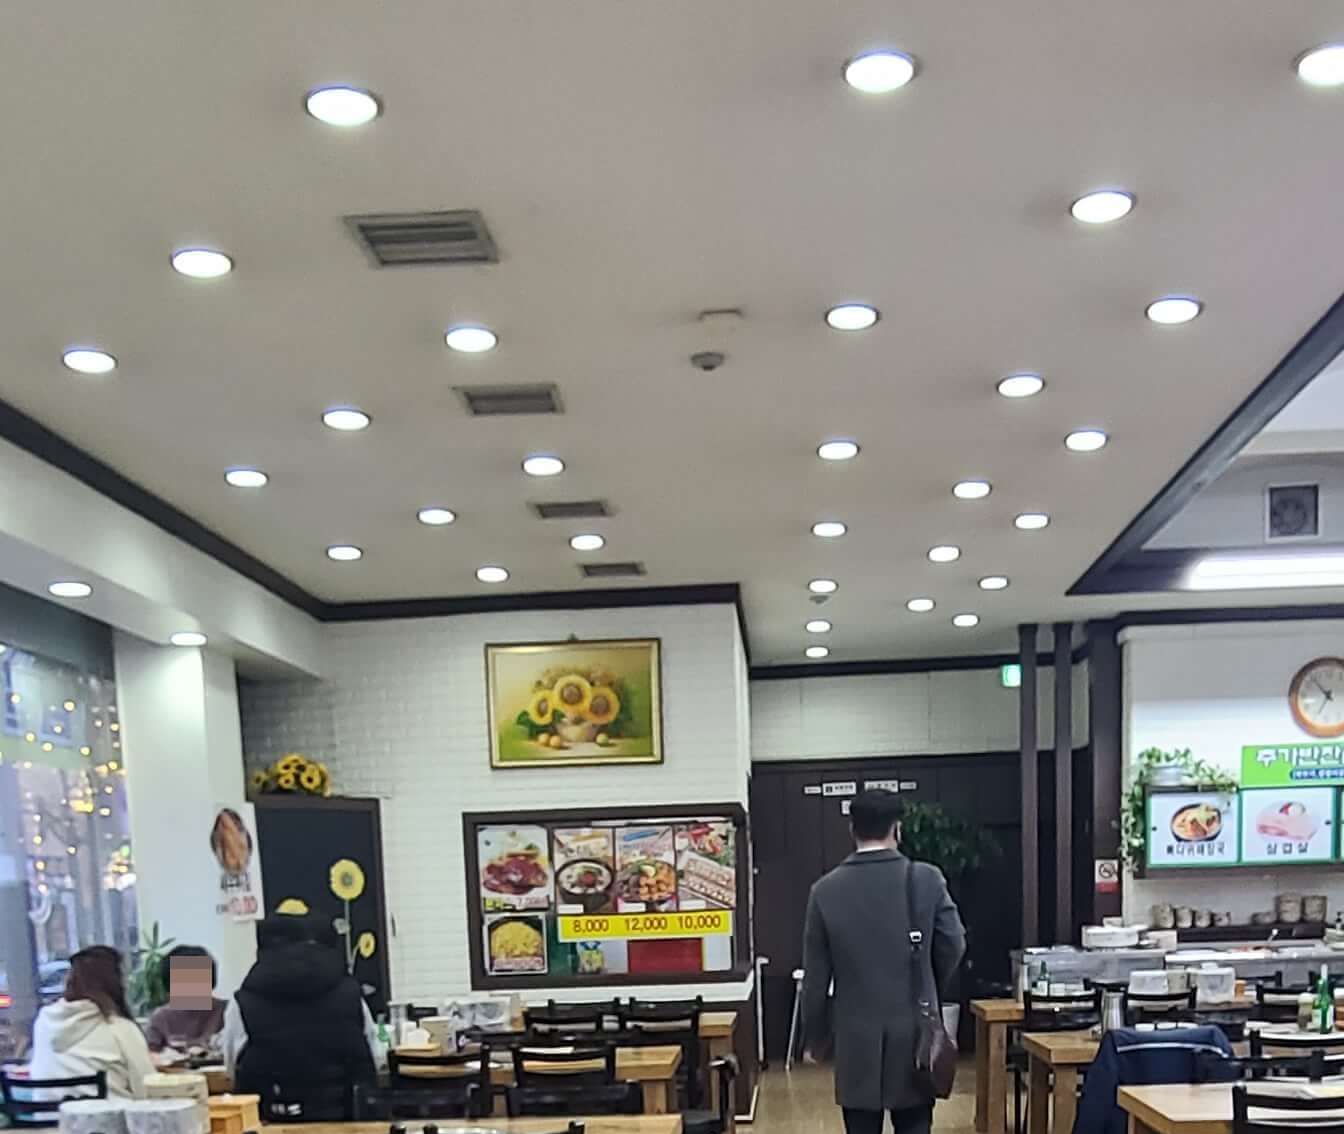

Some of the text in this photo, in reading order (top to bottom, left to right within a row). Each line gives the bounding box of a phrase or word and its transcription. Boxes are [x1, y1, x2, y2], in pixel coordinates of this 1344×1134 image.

[1266, 841, 1309, 856] 삼겹살
[573, 914, 721, 934] 8,000 12,000 10,000
